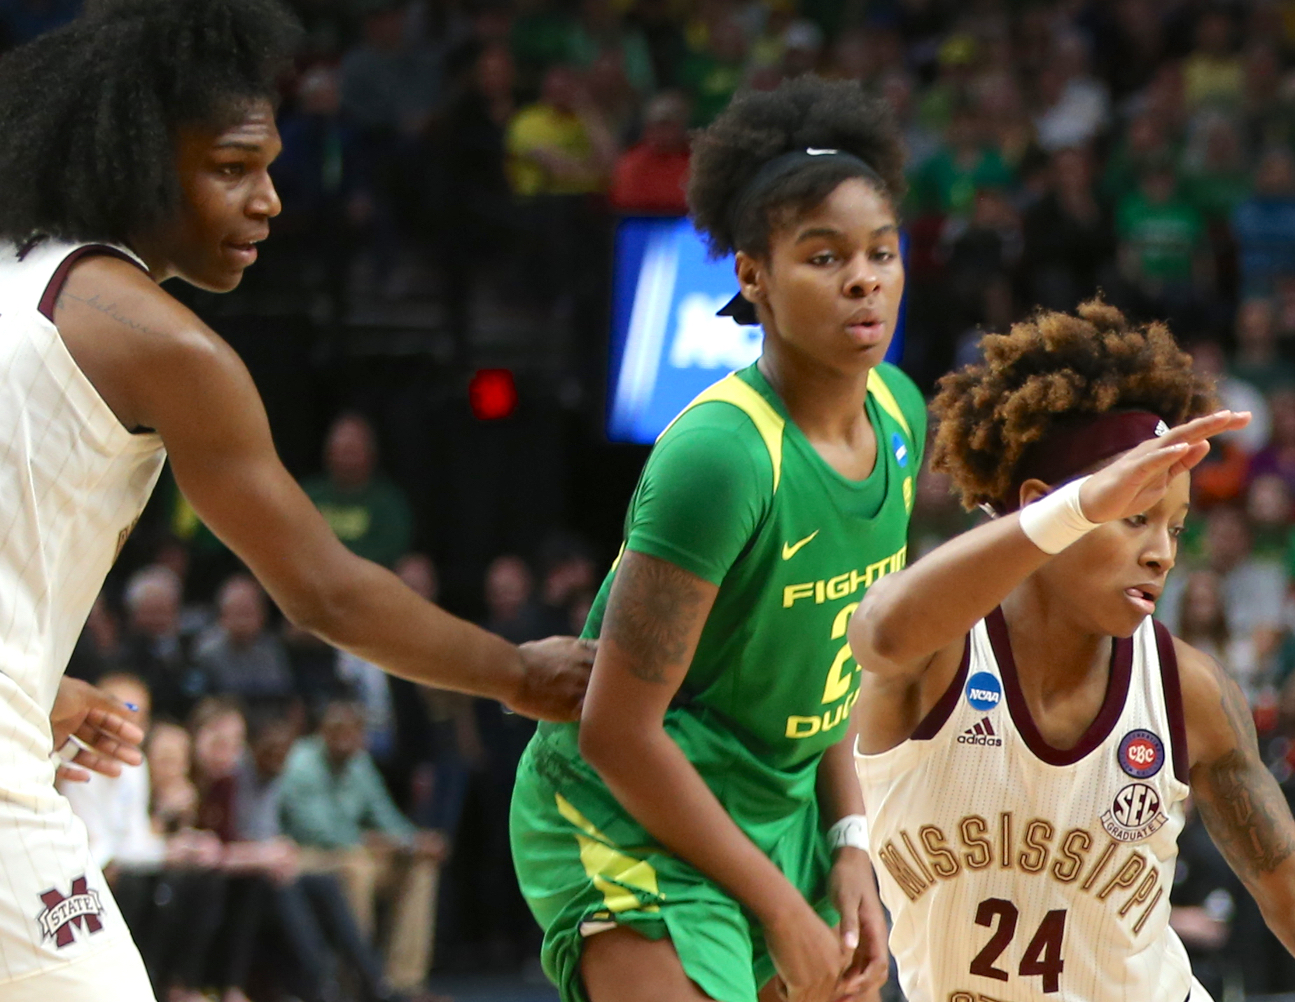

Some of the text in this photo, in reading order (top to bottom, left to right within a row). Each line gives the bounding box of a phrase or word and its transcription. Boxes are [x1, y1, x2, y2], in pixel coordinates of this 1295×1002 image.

[783, 545, 907, 608] FIGHTIN
[969, 688, 1000, 703] NCAA
[957, 735, 1002, 747] adidas
[1128, 744, 1154, 763] CBC
[1115, 784, 1159, 827] SEC
[1106, 821, 1156, 841] GRADUATE
[879, 811, 1164, 937] MISSISSIPPI
[51, 897, 93, 926] STATE
[969, 897, 1067, 994] 24
